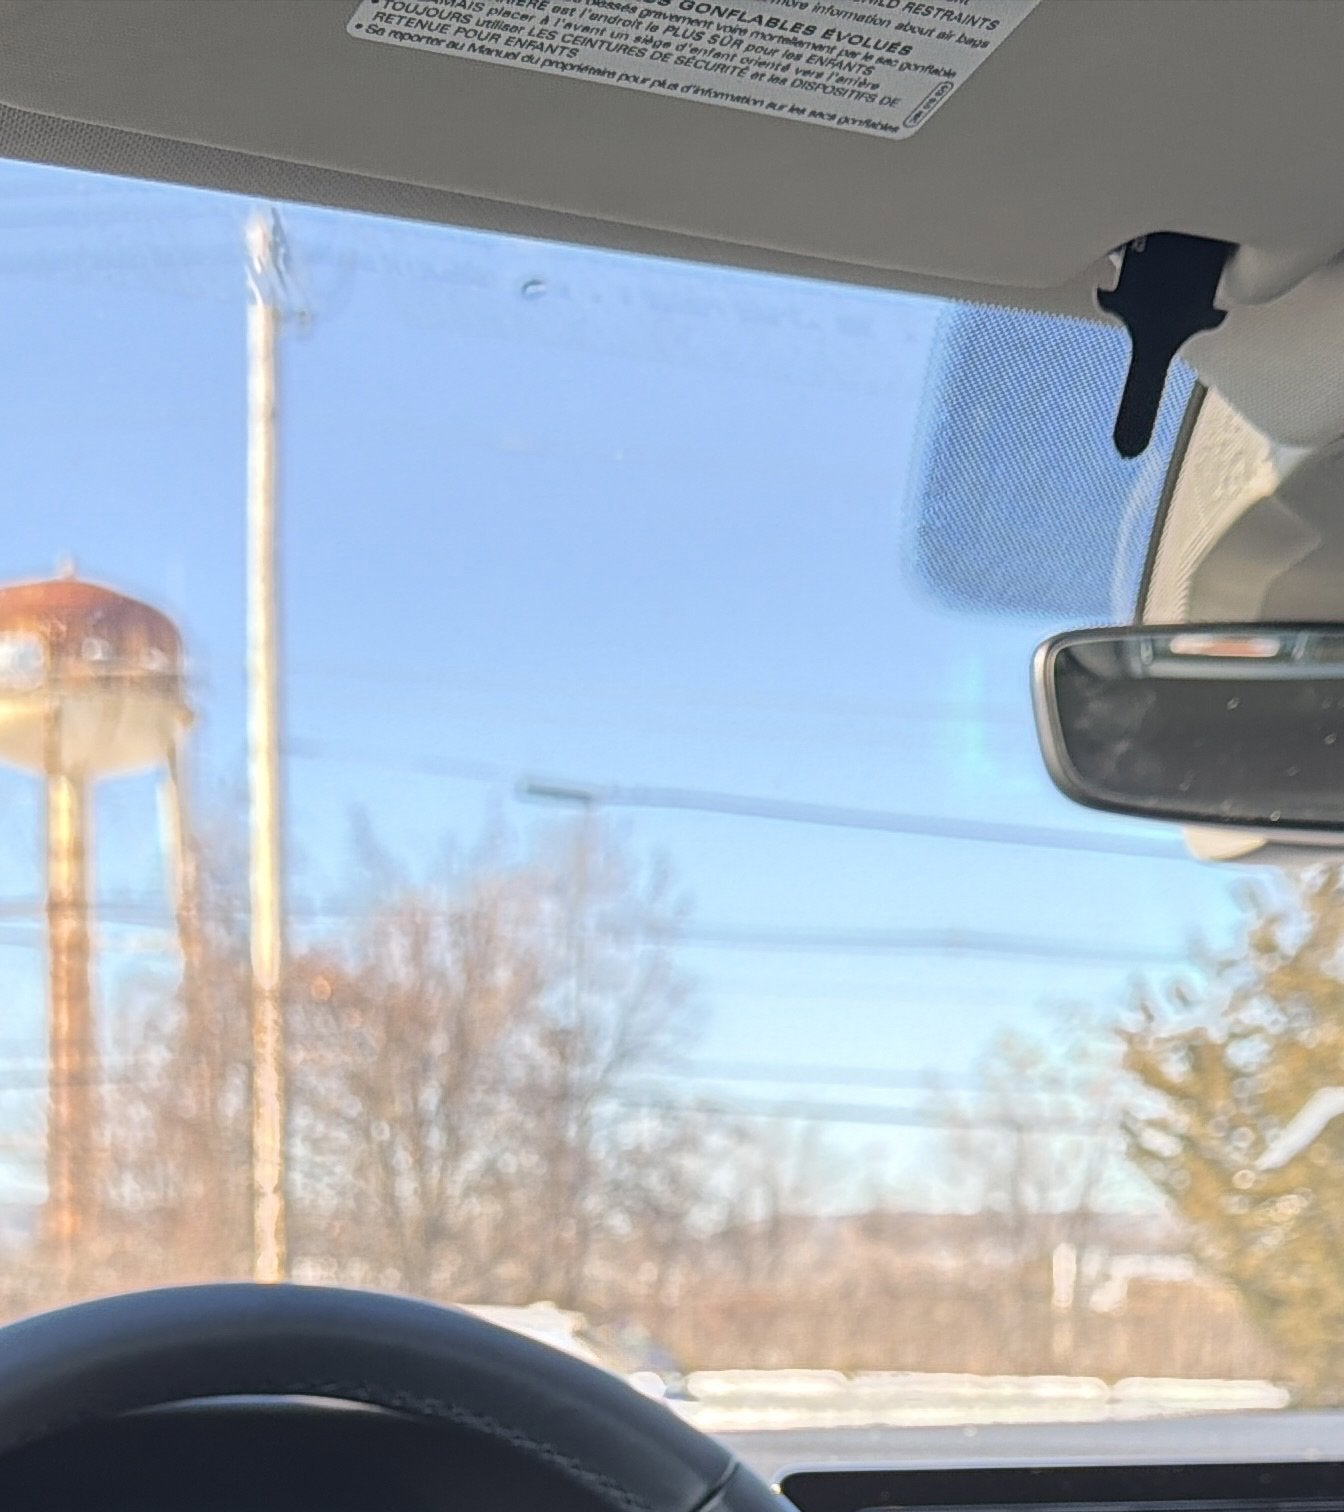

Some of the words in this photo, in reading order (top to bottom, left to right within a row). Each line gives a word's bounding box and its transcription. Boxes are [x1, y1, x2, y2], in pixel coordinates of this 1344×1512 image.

[372, 11, 451, 34] RETENUE
[453, 26, 501, 44] POUR
[504, 36, 579, 58] ENFANTS
[552, 6, 576, 17] est
[579, 8, 644, 30] l'endroit
[645, 22, 659, 32] le
[662, 25, 706, 41] PLUS
[707, 34, 744, 49] SÛR
[743, 44, 780, 57] pour
[782, 49, 803, 61] les
[805, 54, 875, 75] ENFANTS
[638, 8, 714, 29] gravement
[836, 48, 861, 59] par
[875, 56, 899, 67] sac
[679, 0, 817, 35] GONFLABLES
[821, 28, 913, 55] ÉVOLUÉS
[812, 2, 891, 28] information
[895, 21, 936, 37] about
[936, 30, 955, 41] air
[955, 33, 990, 48] bags
[902, 2, 1000, 30] RESTRAINTS
[365, 24, 385, 36] Se
[388, 30, 446, 46] reporter
[446, 41, 465, 50] au
[467, 43, 521, 60] Manuel
[521, 54, 541, 64] du
[617, 73, 651, 84] pour
[681, 84, 764, 106] d'information
[383, 0, 473, 24] TOUJOURS
[475, 18, 525, 34] utiliser
[528, 26, 558, 40] LES
[561, 34, 648, 57] CEINTURES
[650, 48, 673, 62] DE
[674, 55, 749, 78] SÉCURITÉ
[750, 72, 766, 81] et
[767, 74, 788, 85] les
[790, 78, 878, 103] DISPOSITIFS
[879, 96, 901, 107] DE
[486, 7, 536, 22] placer
[553, 18, 606, 36] l'avant
[610, 31, 629, 41] un
[633, 35, 671, 49] siège
[675, 43, 737, 62] d'enfant
[740, 57, 791, 72] orienté
[826, 72, 880, 90] l'arrière
